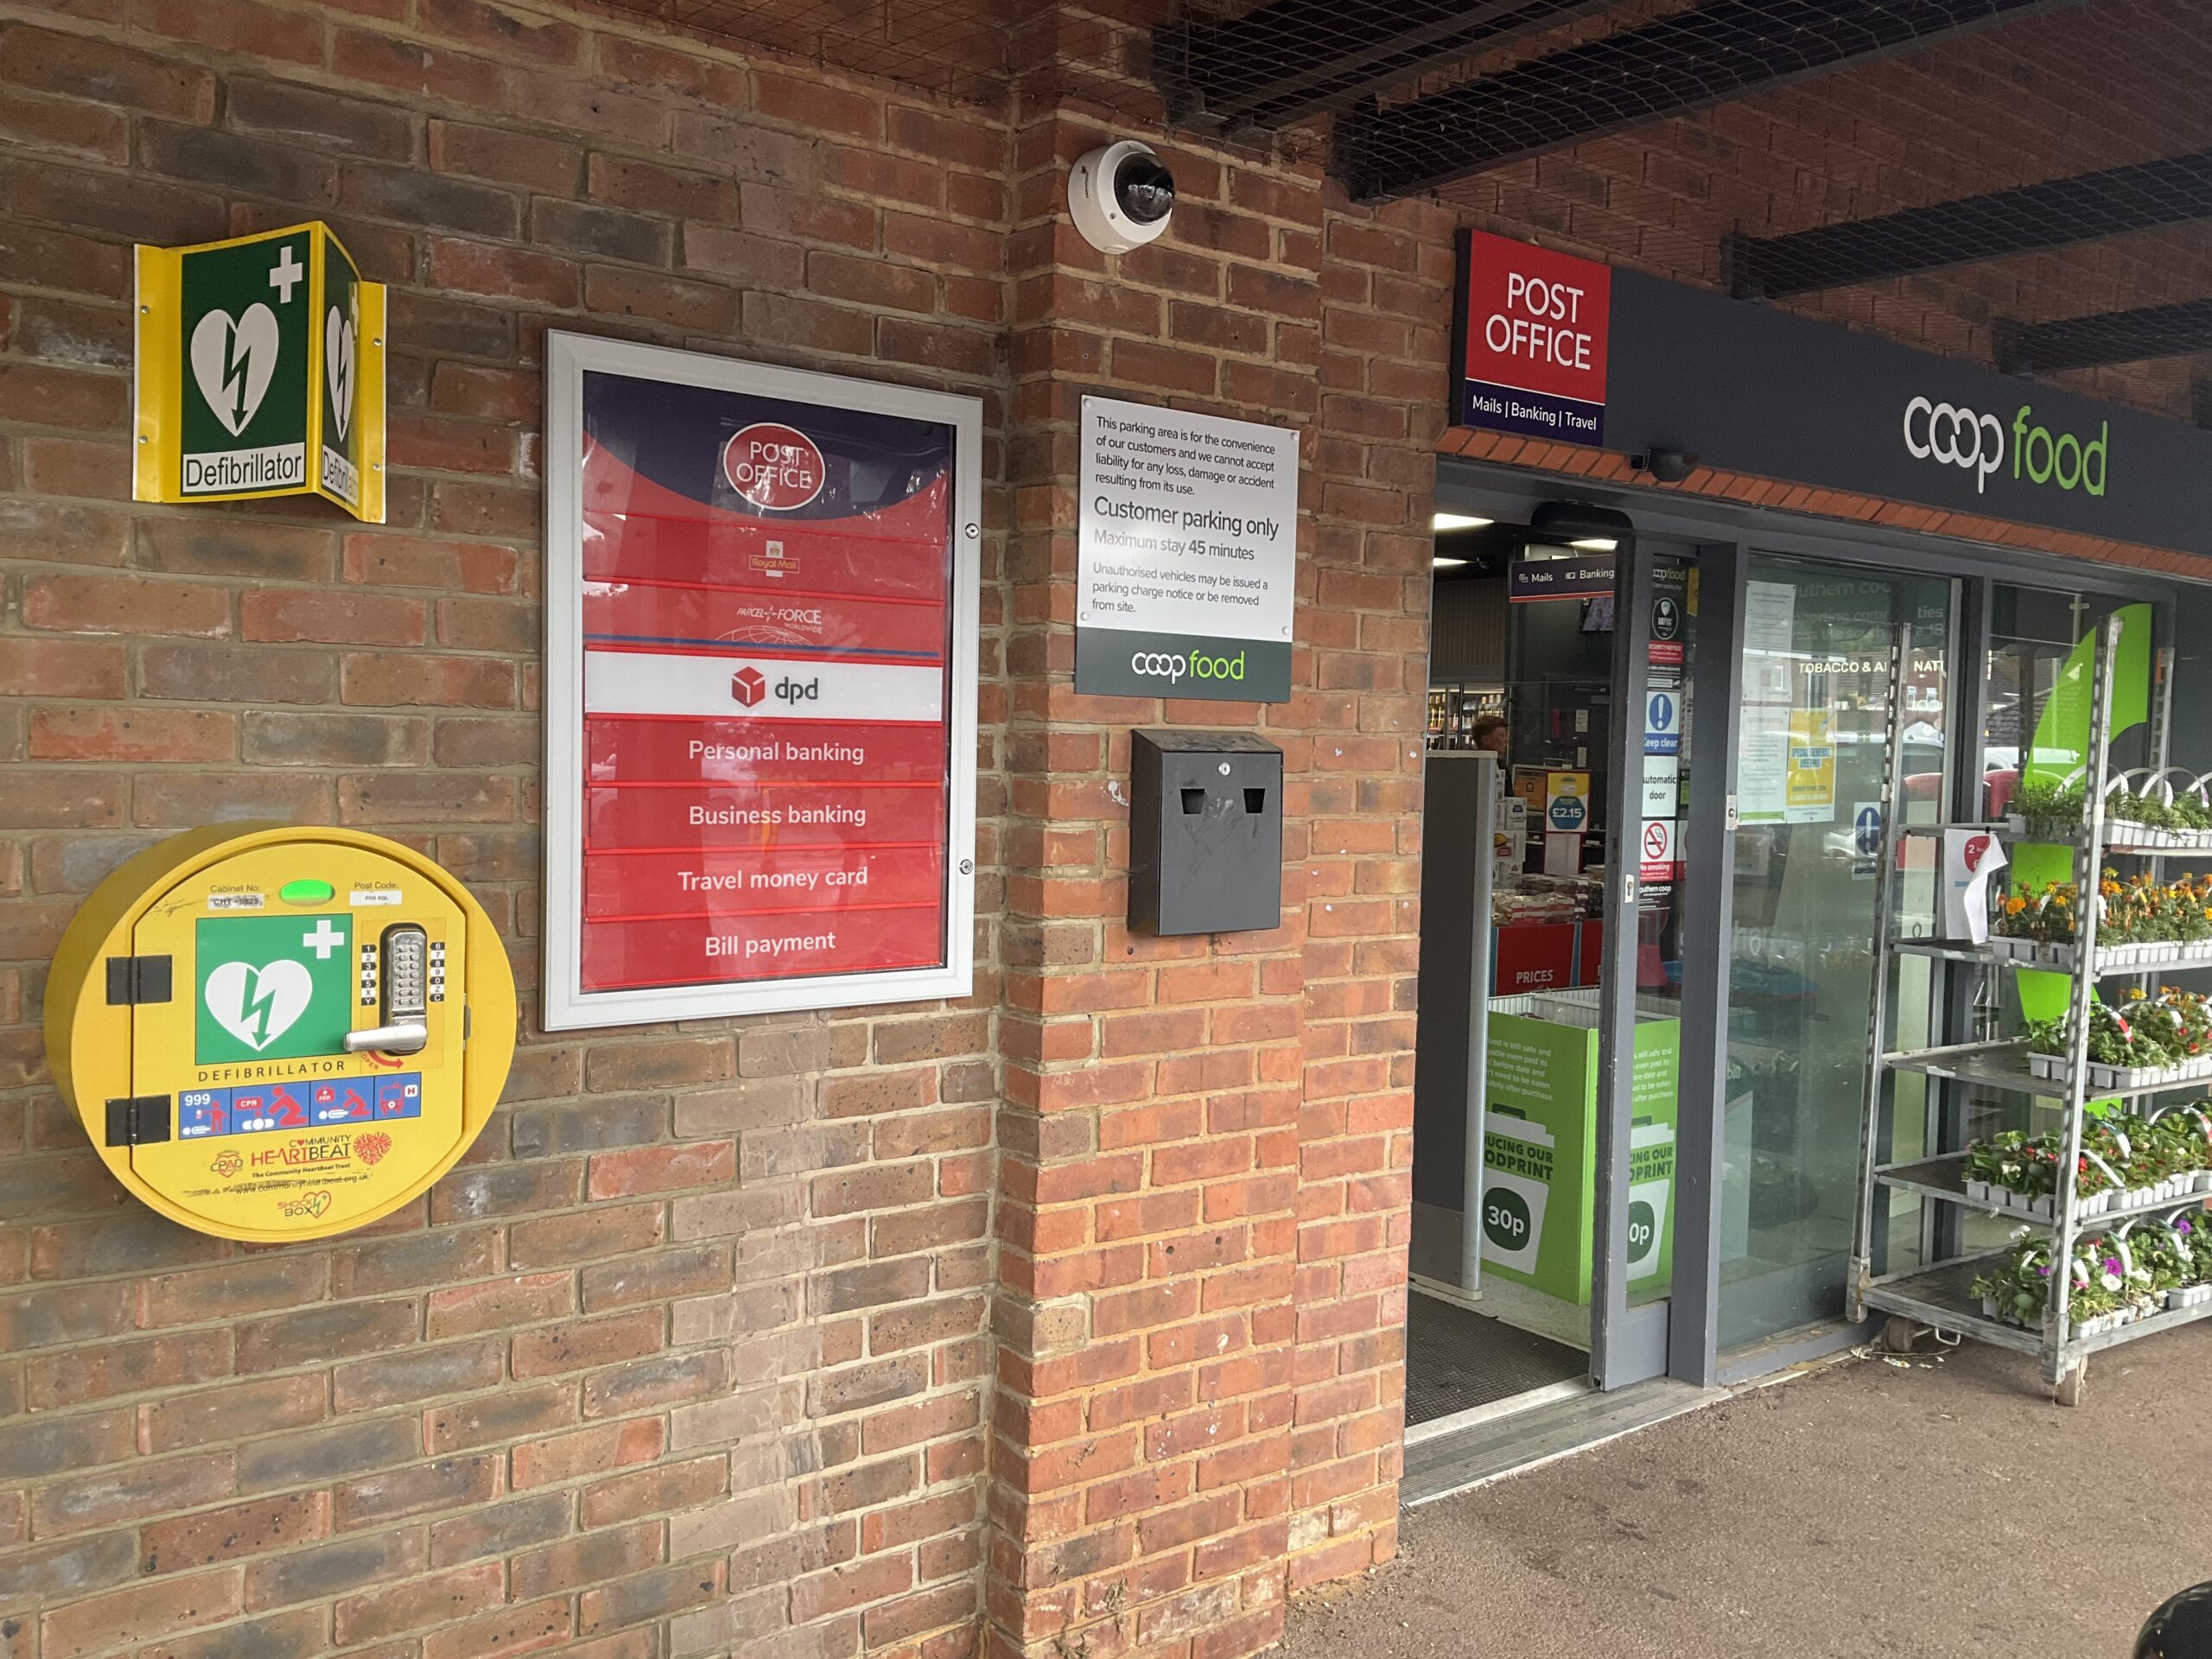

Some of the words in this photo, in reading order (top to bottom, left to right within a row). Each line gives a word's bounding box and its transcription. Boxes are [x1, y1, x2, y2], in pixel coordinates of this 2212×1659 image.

[1507, 272, 1584, 324] POST
[1485, 314, 1592, 371] OFFICE
[1472, 395, 1502, 414] Mails
[1511, 402, 1556, 426] Banking
[1565, 412, 1597, 431] Travel
[1096, 416, 1116, 429] This
[1120, 422, 1155, 438] parking
[1158, 429, 1178, 439] area
[1181, 429, 1188, 441] is
[1191, 431, 1203, 442] for
[1205, 434, 1219, 446] the
[1222, 439, 1275, 454] convenience
[750, 441, 804, 467] POST
[1096, 435, 1106, 446] of
[1109, 439, 1125, 448] our
[1128, 442, 1176, 456] customers
[1179, 449, 1196, 460] and
[1198, 453, 1211, 462] we
[1214, 454, 1244, 467] cannot
[1246, 460, 1274, 473] accept
[1904, 396, 2005, 494] coop
[2012, 405, 2107, 497] food
[186, 452, 302, 487] Defibrillator
[736, 462, 811, 489] OFFICE
[1096, 453, 1128, 470] liability
[1131, 458, 1144, 470] for
[1147, 462, 1164, 475] any
[1166, 463, 1185, 477] loss,
[1189, 467, 1224, 483] damage
[1227, 474, 1236, 483] or
[1239, 475, 1274, 489] accident
[1096, 474, 1136, 490] resulting
[1140, 477, 1160, 490] from
[1163, 480, 1173, 493] its
[1176, 485, 1194, 495] use.
[1094, 495, 1179, 524] Customer
[1182, 510, 1242, 537] parking
[1246, 518, 1279, 541] only
[1094, 528, 1157, 550] Maximum
[1160, 538, 1185, 556] stay
[1189, 539, 1205, 555] 45
[1209, 543, 1255, 560] minutes
[752, 557, 776, 569] Royal
[778, 558, 796, 569] Mail
[1093, 563, 1157, 579] Unauthorised
[1160, 570, 1196, 583] vehicles
[1198, 575, 1217, 588] may
[1219, 575, 1230, 587] be
[1233, 575, 1261, 589] issued
[1262, 581, 1268, 590] a
[1531, 572, 1554, 582] Mails
[1580, 569, 1614, 579] Banking
[1667, 568, 1686, 581] food
[1092, 582, 1128, 596] parking
[1131, 584, 1164, 597] charge
[1166, 588, 1193, 600] notice
[1196, 591, 1205, 601] or
[1207, 591, 1218, 602] be
[1221, 594, 1259, 606] removed
[1092, 599, 1114, 611] from
[1116, 601, 1135, 613] site.
[785, 623, 823, 634] WORLDWIDE
[1131, 652, 1186, 684] coop
[1189, 649, 1244, 680] food
[1799, 661, 1859, 673] TOBACCO
[1862, 661, 1871, 672] &
[774, 677, 818, 705] dpd
[1661, 737, 1677, 747] clear
[689, 741, 779, 761] Personal
[786, 741, 864, 766] banking
[1649, 790, 1666, 799] door
[690, 806, 781, 825] Business
[788, 805, 866, 827] banking
[1552, 807, 1582, 818] £2.15
[677, 870, 742, 891] Travel
[749, 871, 816, 891] money
[825, 867, 868, 886] card
[705, 936, 738, 956] Bill
[746, 931, 836, 957] payment
[1516, 969, 1554, 984] PRICES
[1510, 1042, 1522, 1051] still
[1522, 1045, 1536, 1054] safe
[1538, 1048, 1551, 1057] and
[198, 1060, 346, 1082] DEFIBRILLATOR
[361, 1054, 379, 1071] OPEN
[1493, 1060, 1514, 1071] before
[1516, 1065, 1530, 1074] date
[1532, 1069, 1545, 1077] and
[1540, 1058, 1548, 1067] its
[1495, 1071, 1511, 1080] need
[1530, 1080, 1550, 1090] eaten
[184, 1093, 211, 1107] 999
[408, 1087, 416, 1096] H
[1505, 1084, 1520, 1093] after
[1522, 1088, 1554, 1102] purchase.
[240, 1099, 257, 1108] CPR
[251, 1142, 351, 1166] HEARTBEAT
[1484, 1135, 1523, 1154] UCING
[1527, 1147, 1554, 1164] OUR
[1652, 1147, 1673, 1160] OUR
[210, 1159, 243, 1173] CPAD
[265, 1168, 302, 1178] Community
[302, 1165, 334, 1173] HeartBeat
[1484, 1149, 1554, 1180] ODPRINT
[235, 1173, 370, 1194] www.communityheartbeat.org.uk
[277, 1198, 313, 1209] SHOCK
[284, 1206, 313, 1217] BOX
[1488, 1205, 1524, 1236] 30p
[1629, 1223, 1649, 1245] 0p
